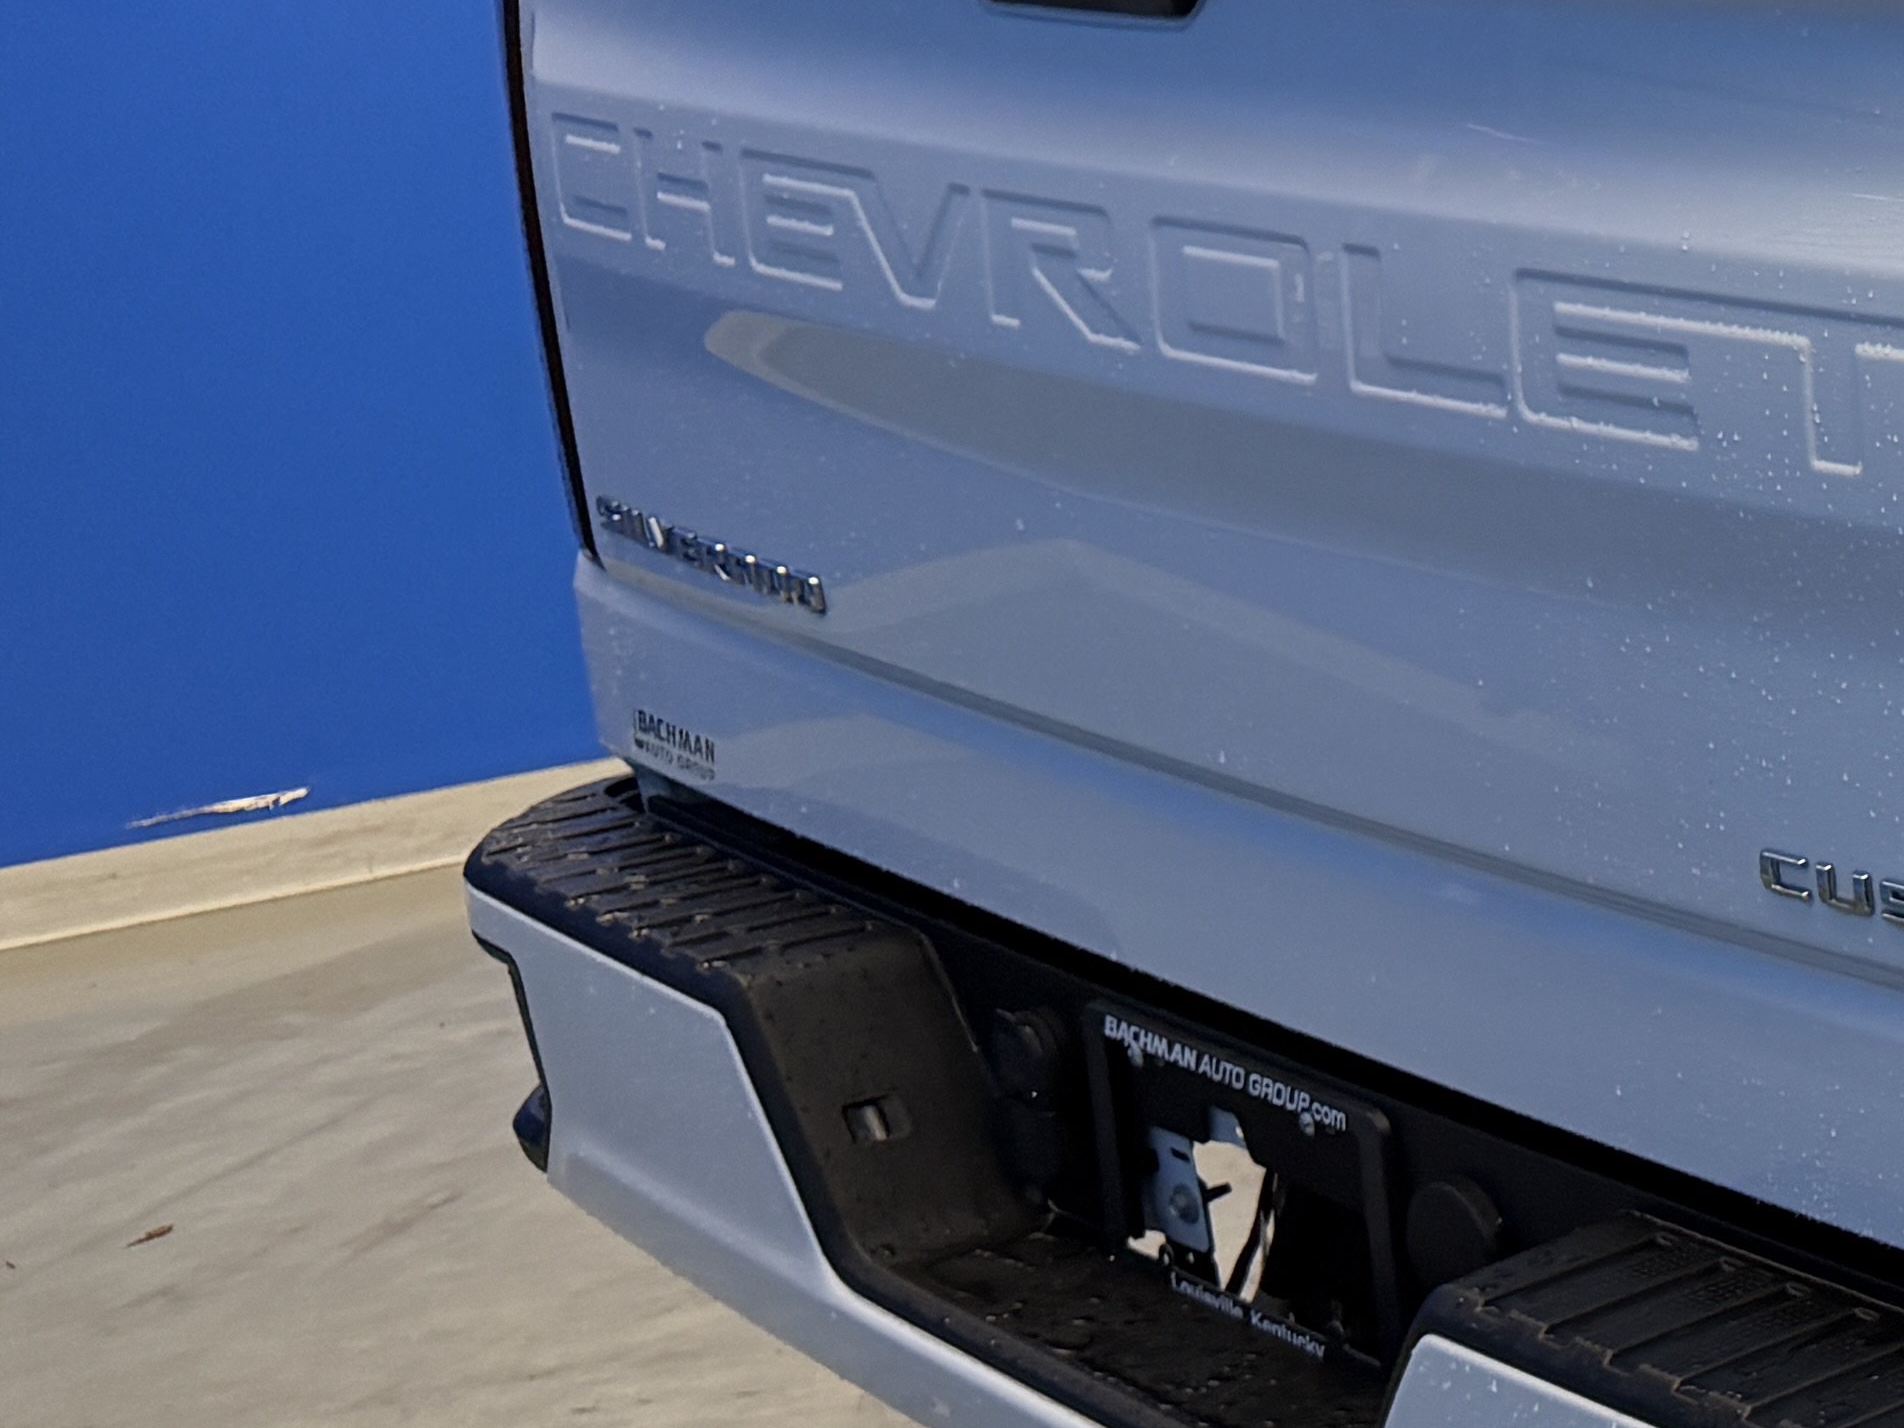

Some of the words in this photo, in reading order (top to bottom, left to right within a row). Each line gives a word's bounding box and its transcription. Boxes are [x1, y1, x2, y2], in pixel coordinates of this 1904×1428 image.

[637, 708, 716, 764] BACHMAN
[1104, 1014, 1197, 1071] BACHMAN
[1198, 1054, 1246, 1091] AUTO
[1250, 1307, 1325, 1359] Kentucky
